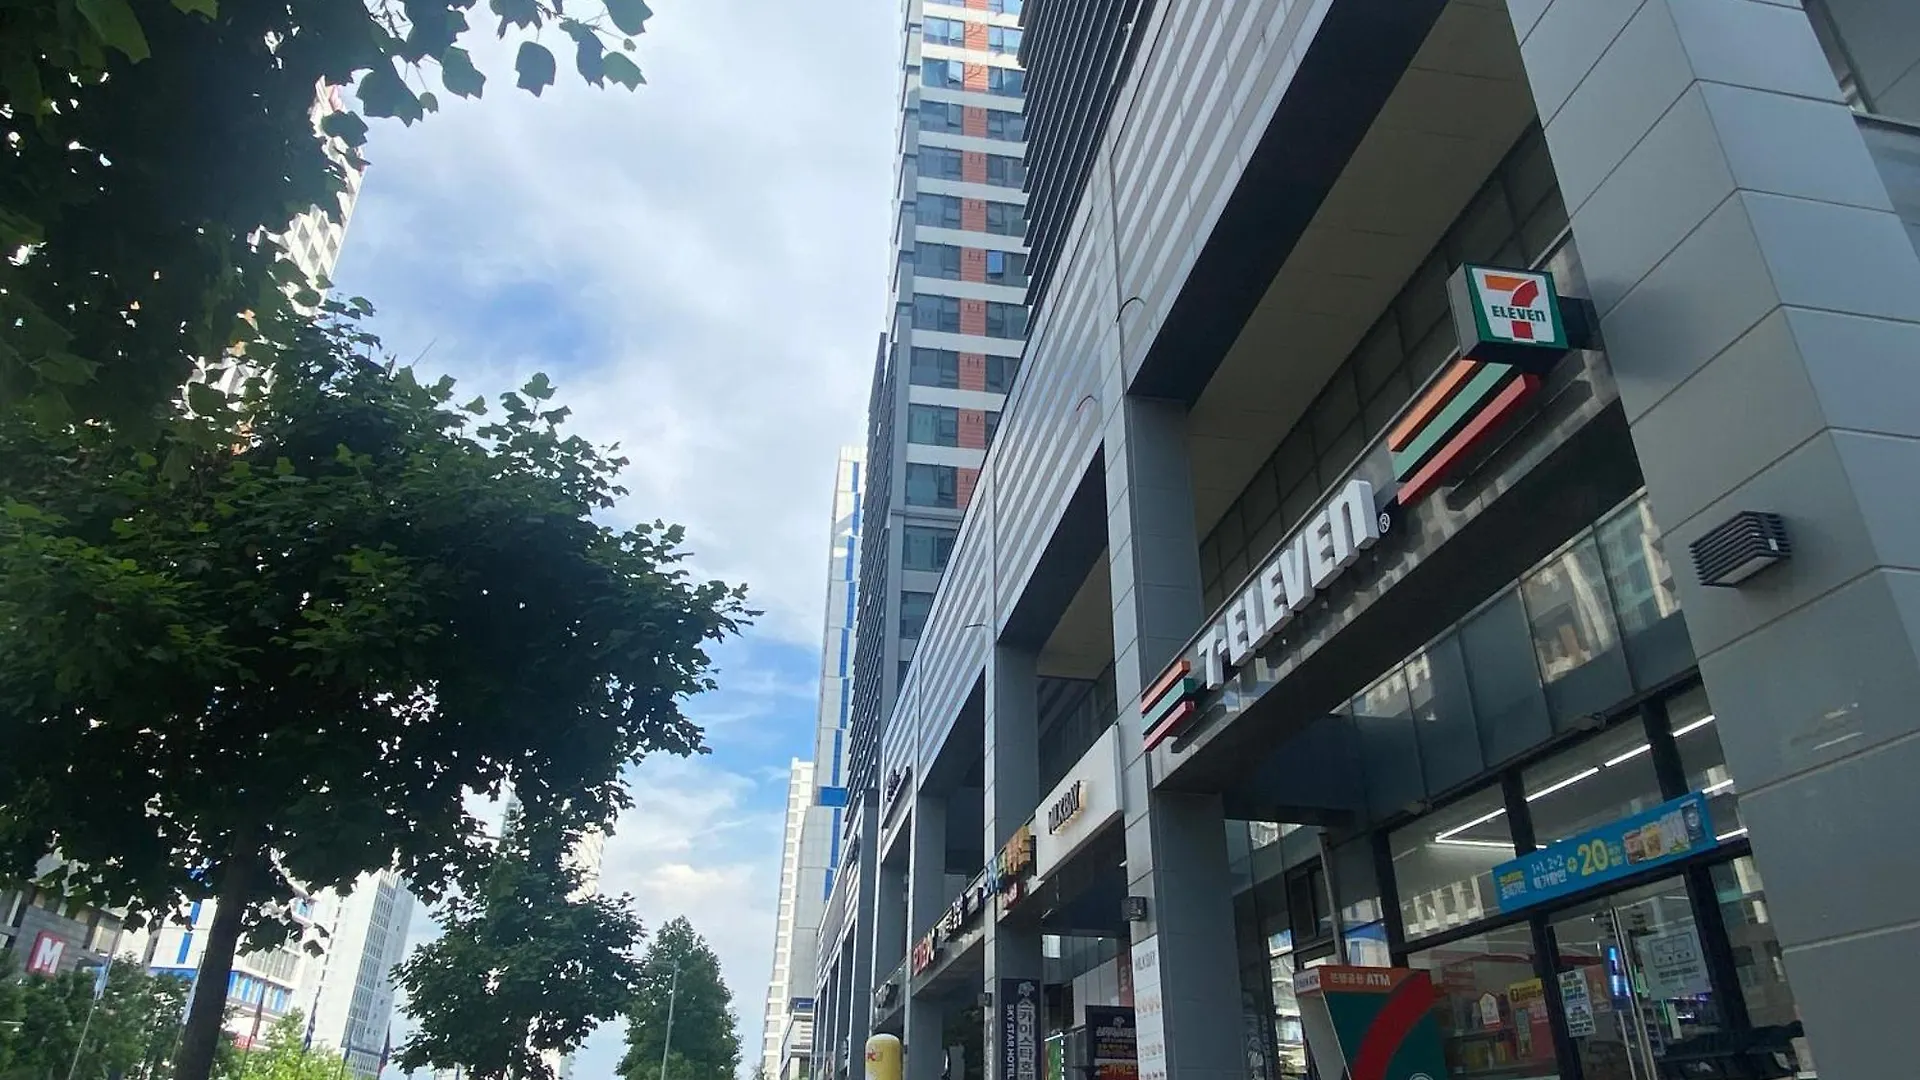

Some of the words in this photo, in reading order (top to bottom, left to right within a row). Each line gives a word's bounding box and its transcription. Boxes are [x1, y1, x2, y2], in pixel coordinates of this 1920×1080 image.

[1484, 274, 1539, 341] 7
[1366, 973, 1391, 986] ATM
[1007, 1004, 1015, 1023] SKY
[1007, 1023, 1015, 1047] STAR
[1007, 1049, 1015, 1080] HOTEL
